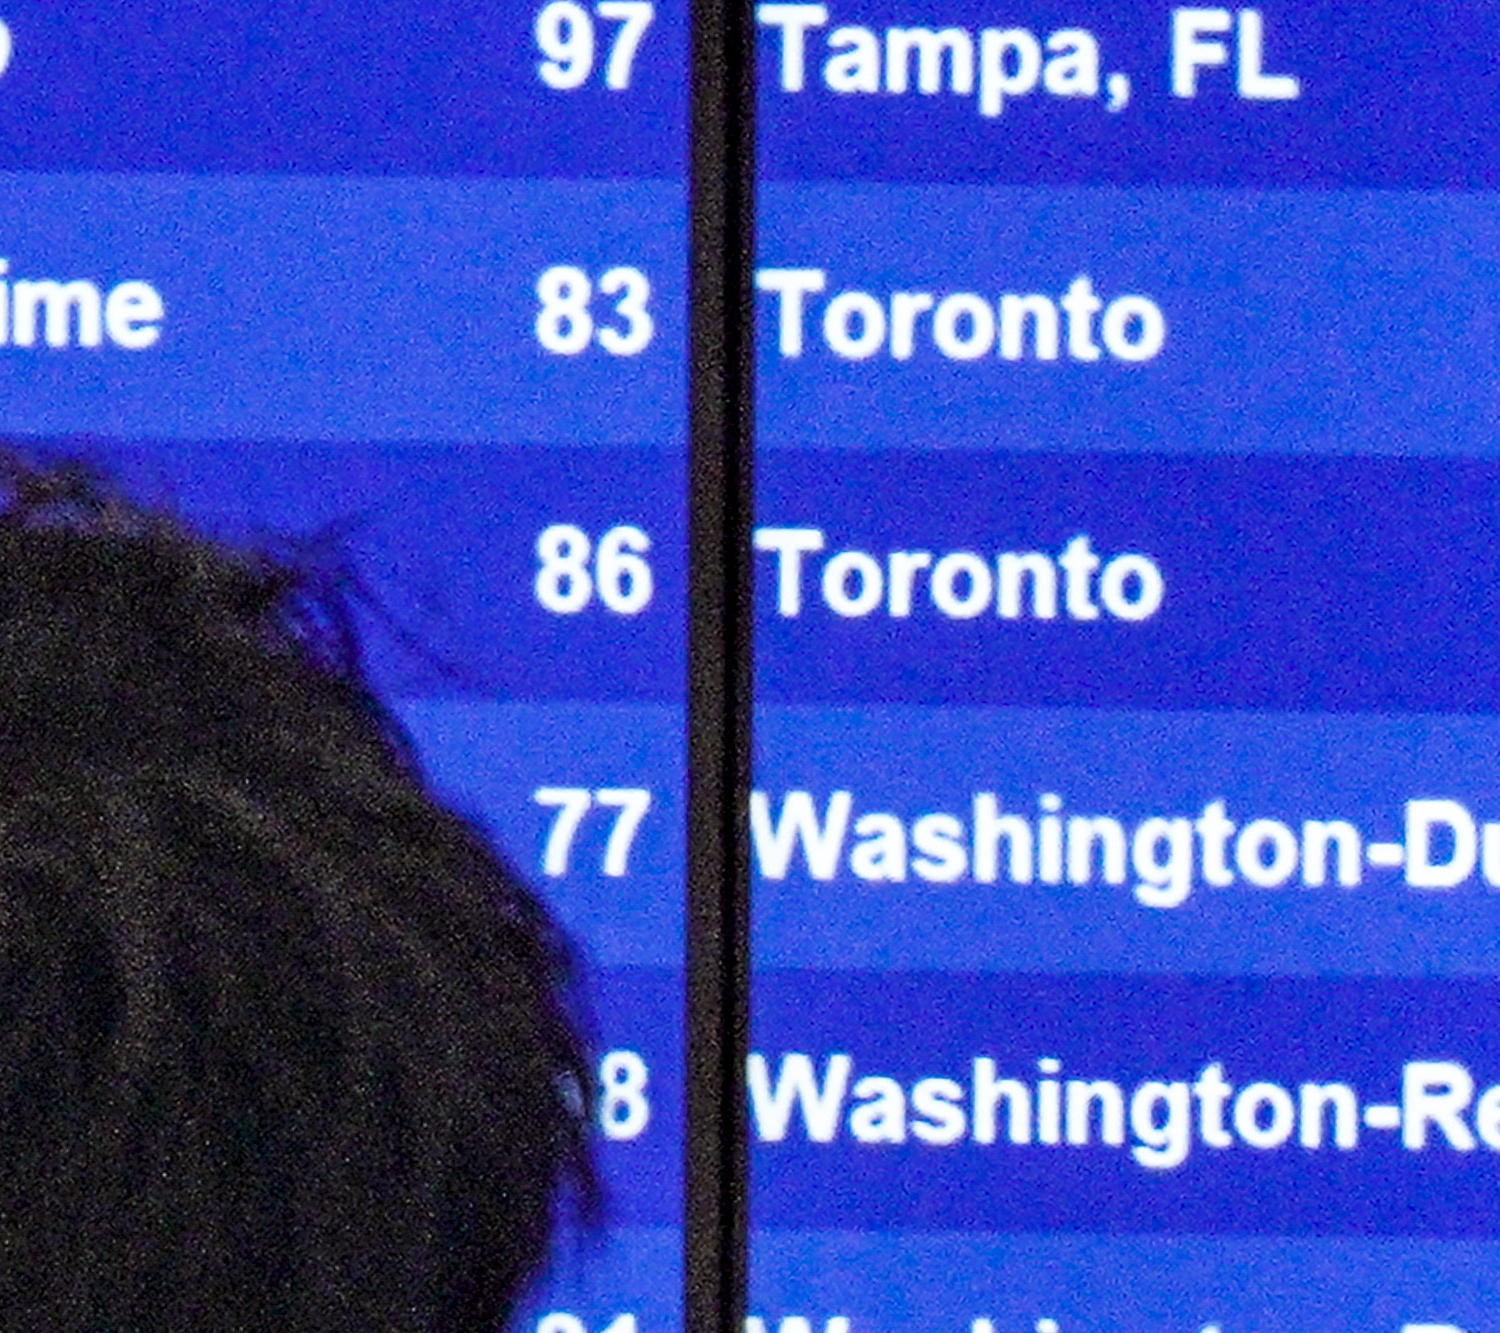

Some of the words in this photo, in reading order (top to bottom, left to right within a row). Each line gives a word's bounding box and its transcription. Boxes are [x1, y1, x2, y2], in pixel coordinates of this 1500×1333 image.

[534, 0, 656, 92] 97
[756, 3, 1131, 119] Tampa,
[1172, 6, 1301, 101] FL
[534, 264, 656, 358] 83
[755, 267, 1168, 364] Toronto
[534, 523, 655, 617] 86
[753, 527, 1166, 623] Toronto
[533, 785, 653, 879] 77
